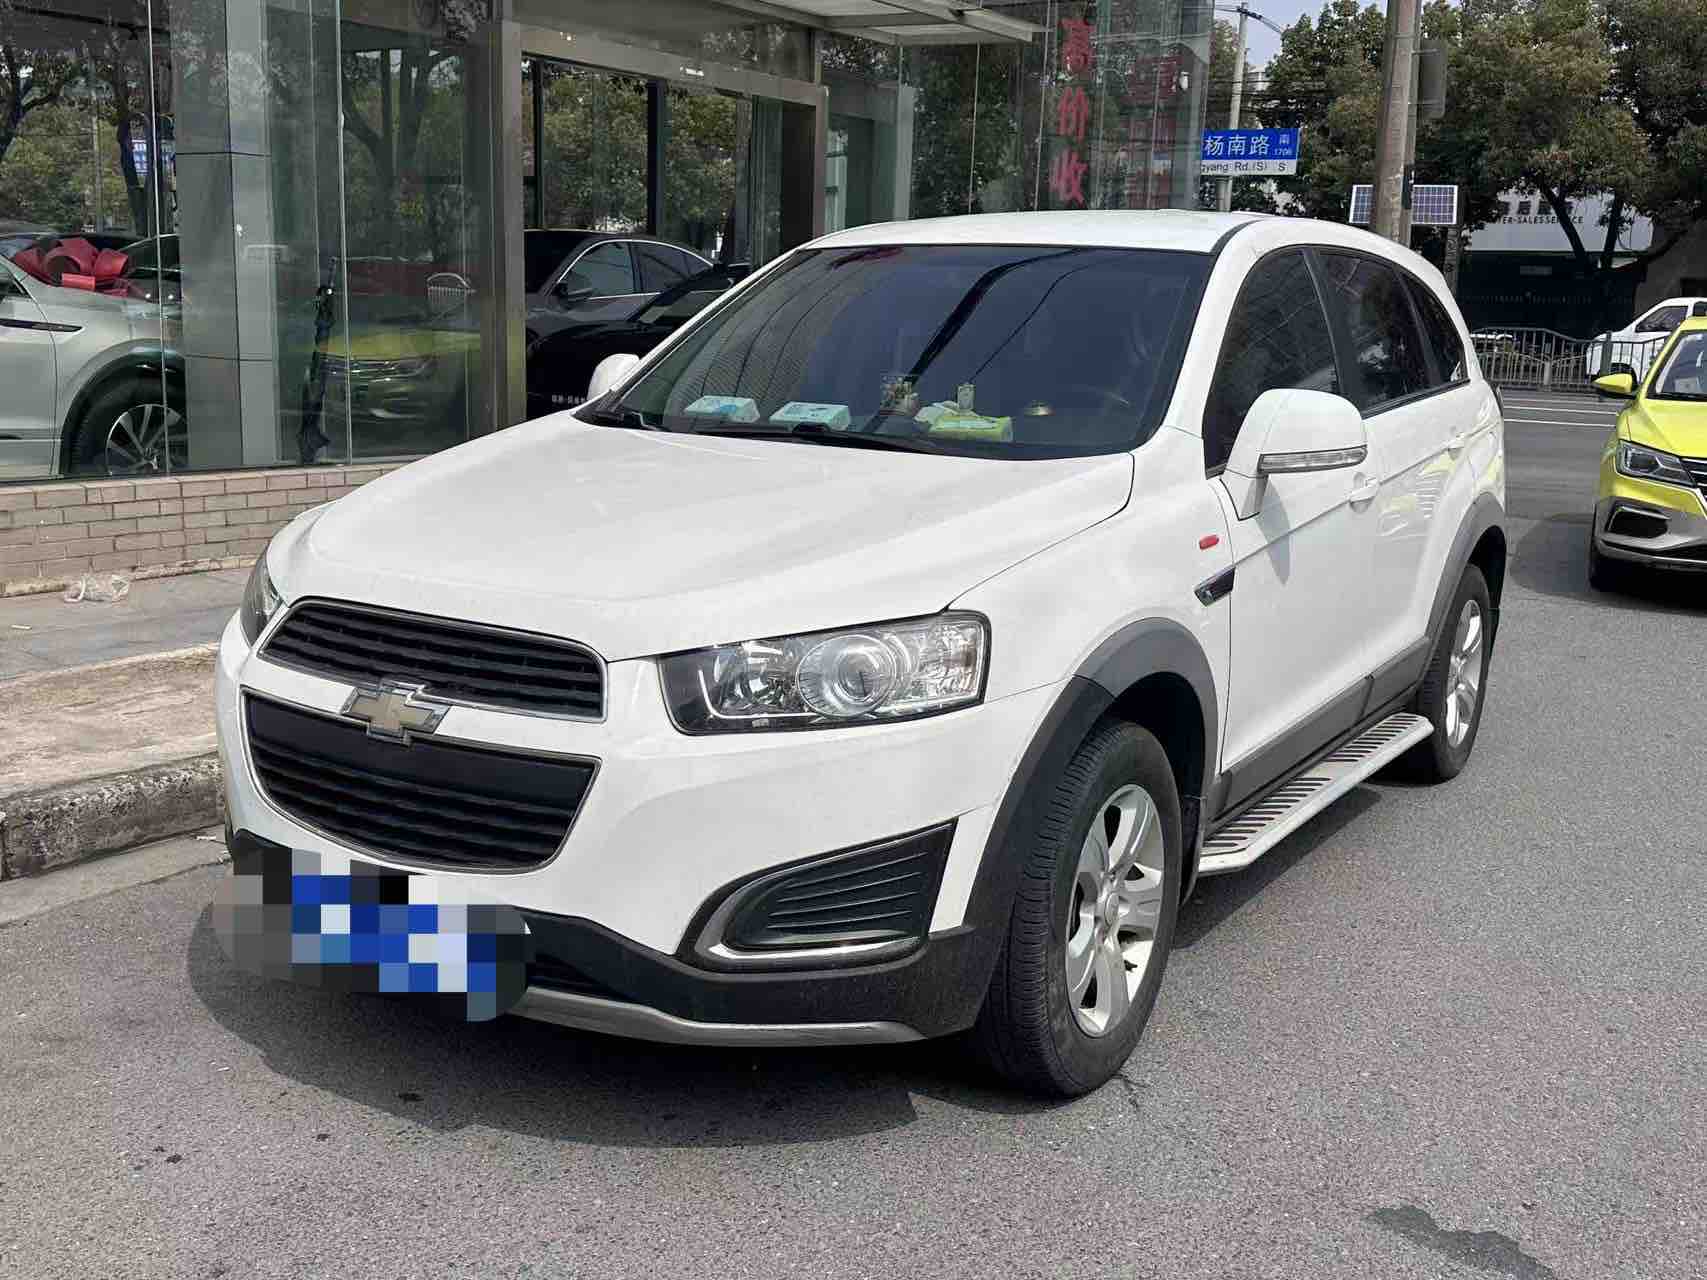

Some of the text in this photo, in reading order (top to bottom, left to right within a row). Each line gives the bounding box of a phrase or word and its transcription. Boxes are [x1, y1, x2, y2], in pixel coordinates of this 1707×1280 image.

[1203, 134, 1270, 156] 杨南路
[1278, 162, 1288, 172] S
